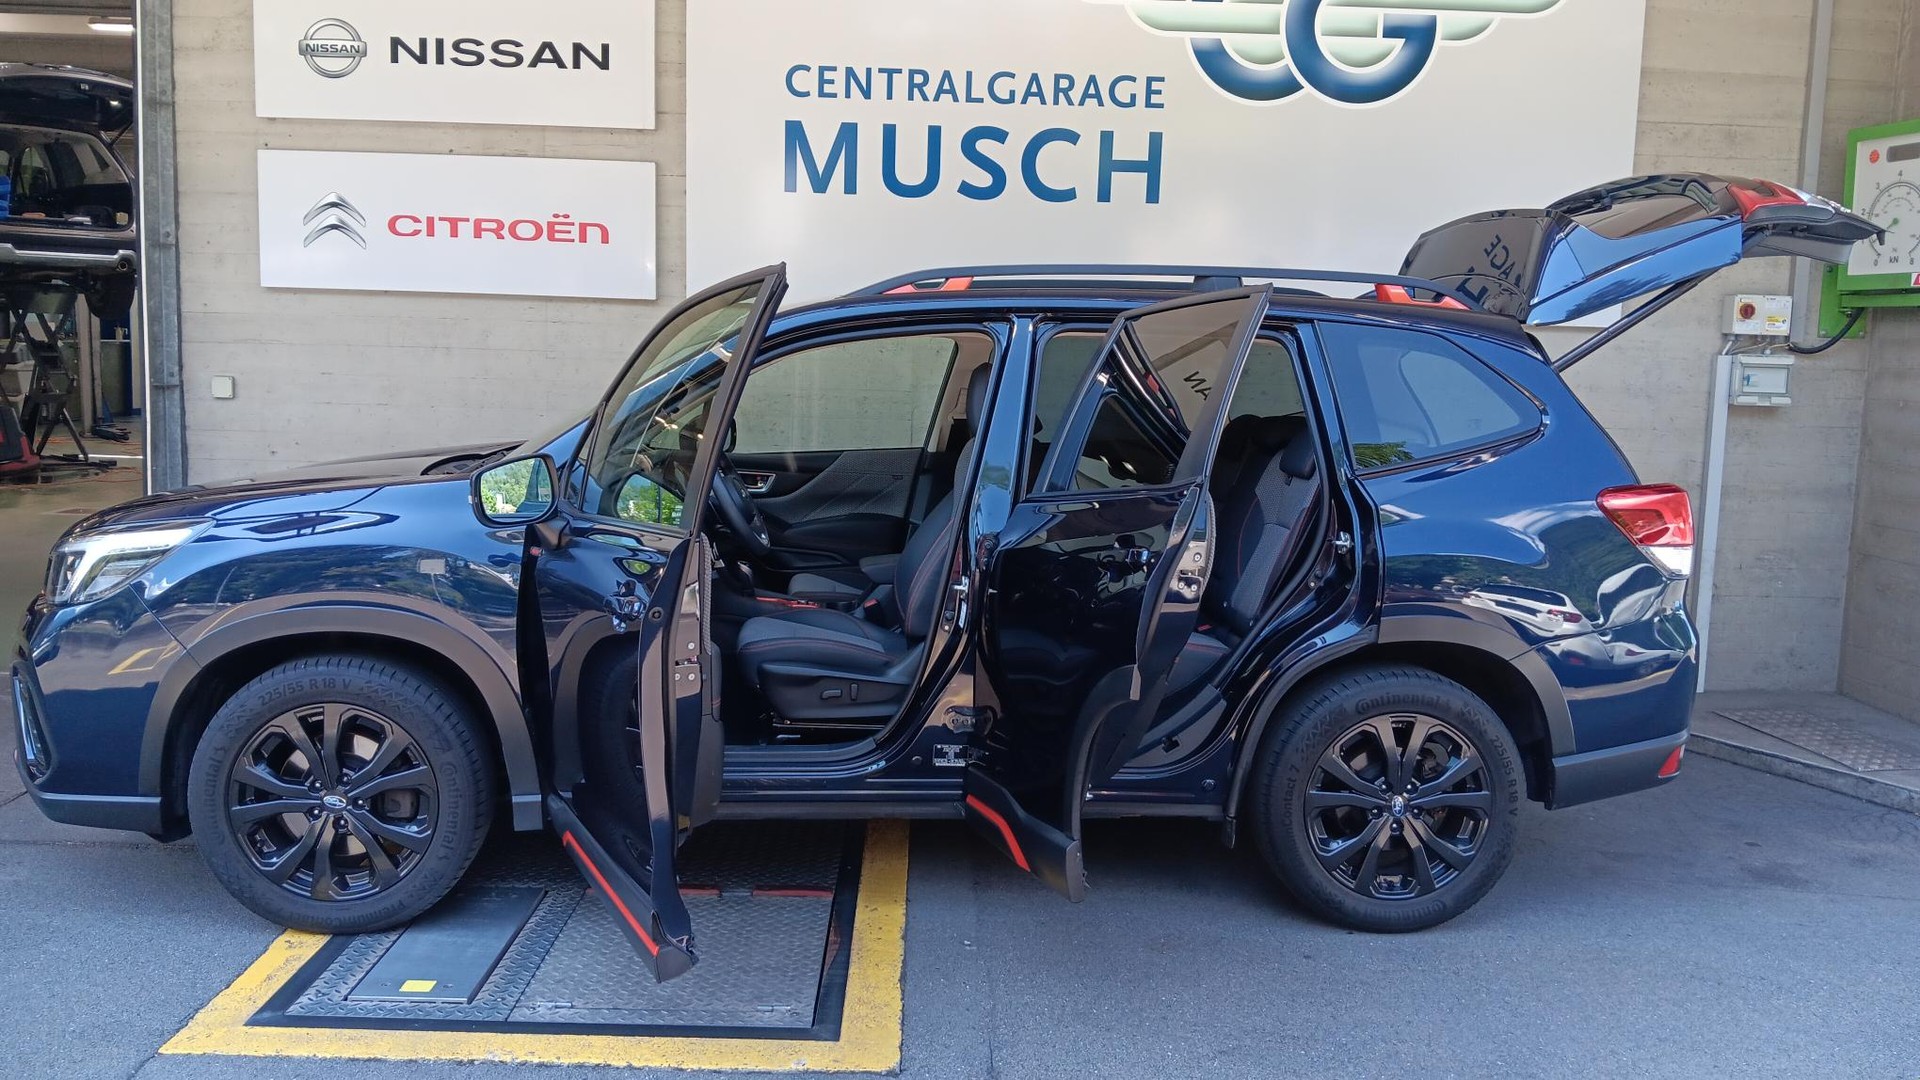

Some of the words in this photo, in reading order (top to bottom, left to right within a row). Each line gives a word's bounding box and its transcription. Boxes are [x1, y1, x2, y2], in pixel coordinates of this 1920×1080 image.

[305, 43, 360, 54] NISSAN
[389, 36, 610, 71] NISSAN
[785, 64, 1166, 109] CENTRALGARAGE
[783, 120, 1163, 204] MUSCH
[258, 681, 304, 706] 225/55
[1355, 692, 1441, 714] Continental
[1490, 735, 1515, 775] 225/55
